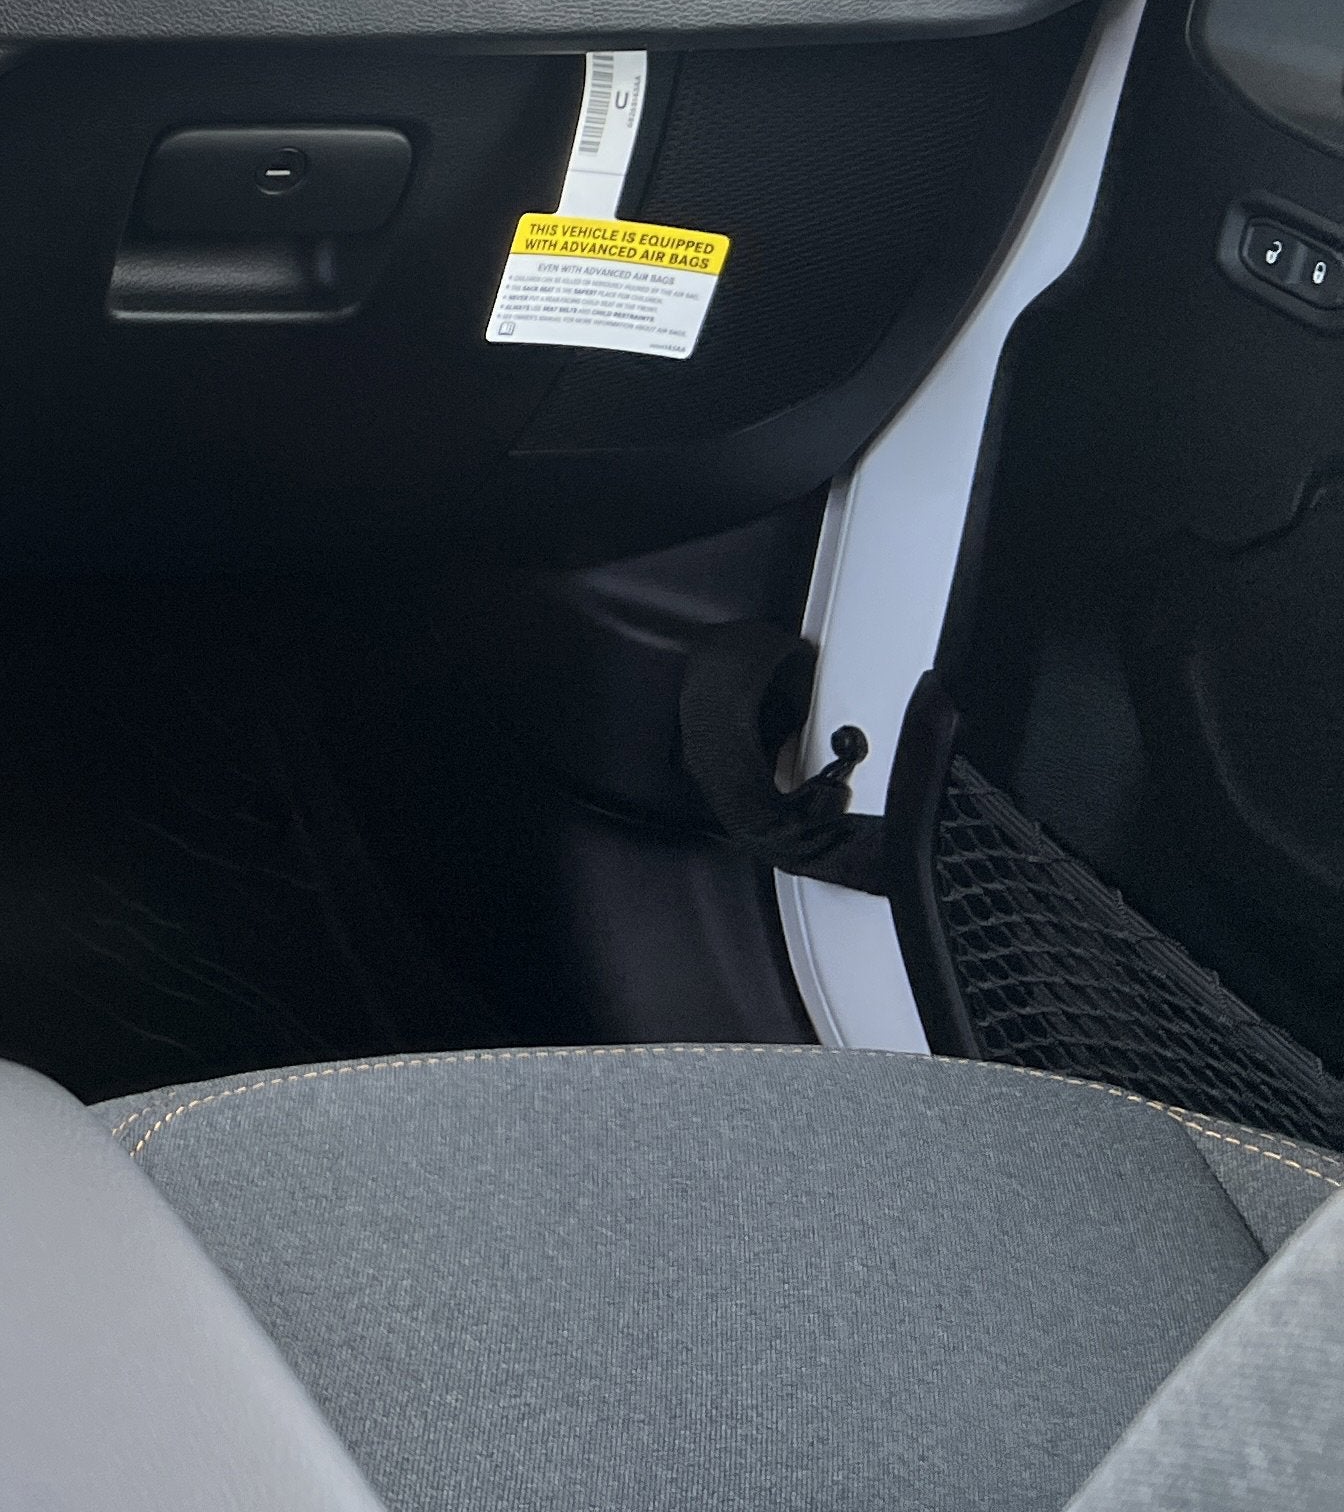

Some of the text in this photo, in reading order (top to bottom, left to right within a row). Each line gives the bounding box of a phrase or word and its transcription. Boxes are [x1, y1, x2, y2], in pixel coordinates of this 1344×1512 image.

[525, 239, 710, 269] WITH ADVANCED AIR BAGS
[530, 224, 715, 255] THIS VEHICLE IS EQUIPPED
[538, 263, 675, 285] EVEN WITH ADVANCED AIR BAGS
